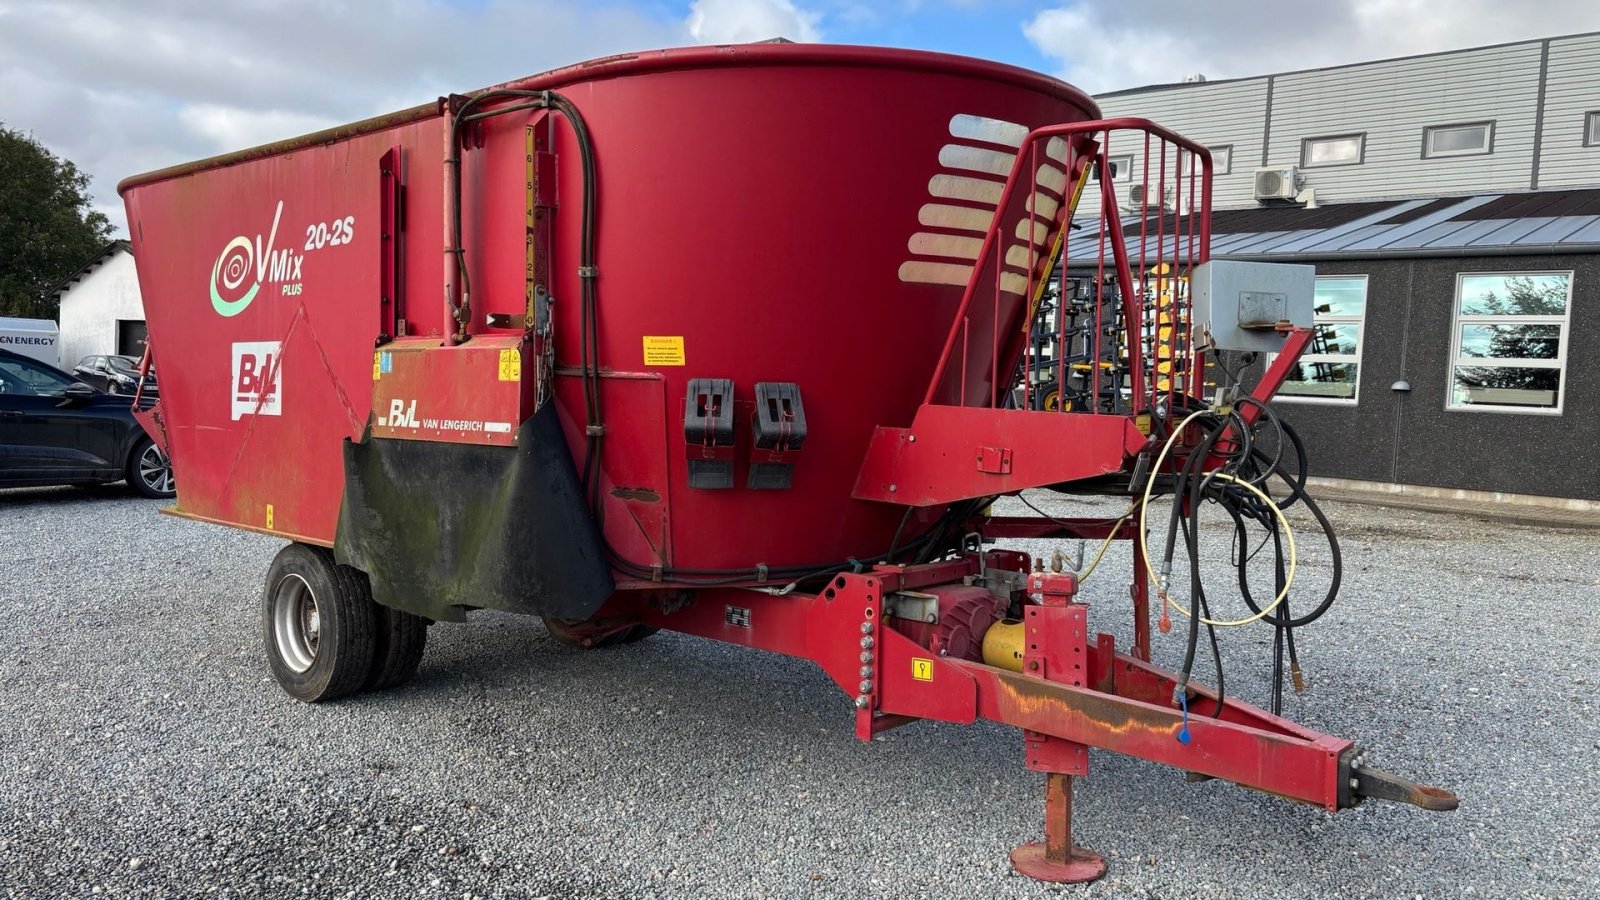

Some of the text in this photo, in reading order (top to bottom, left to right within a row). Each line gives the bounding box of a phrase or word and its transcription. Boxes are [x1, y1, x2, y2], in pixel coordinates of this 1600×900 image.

[304, 215, 355, 251] 20-2S
[282, 283, 303, 296] PLUS
[15, 336, 54, 346] ENERGY
[423, 418, 483, 431] VAN LENGERICH
